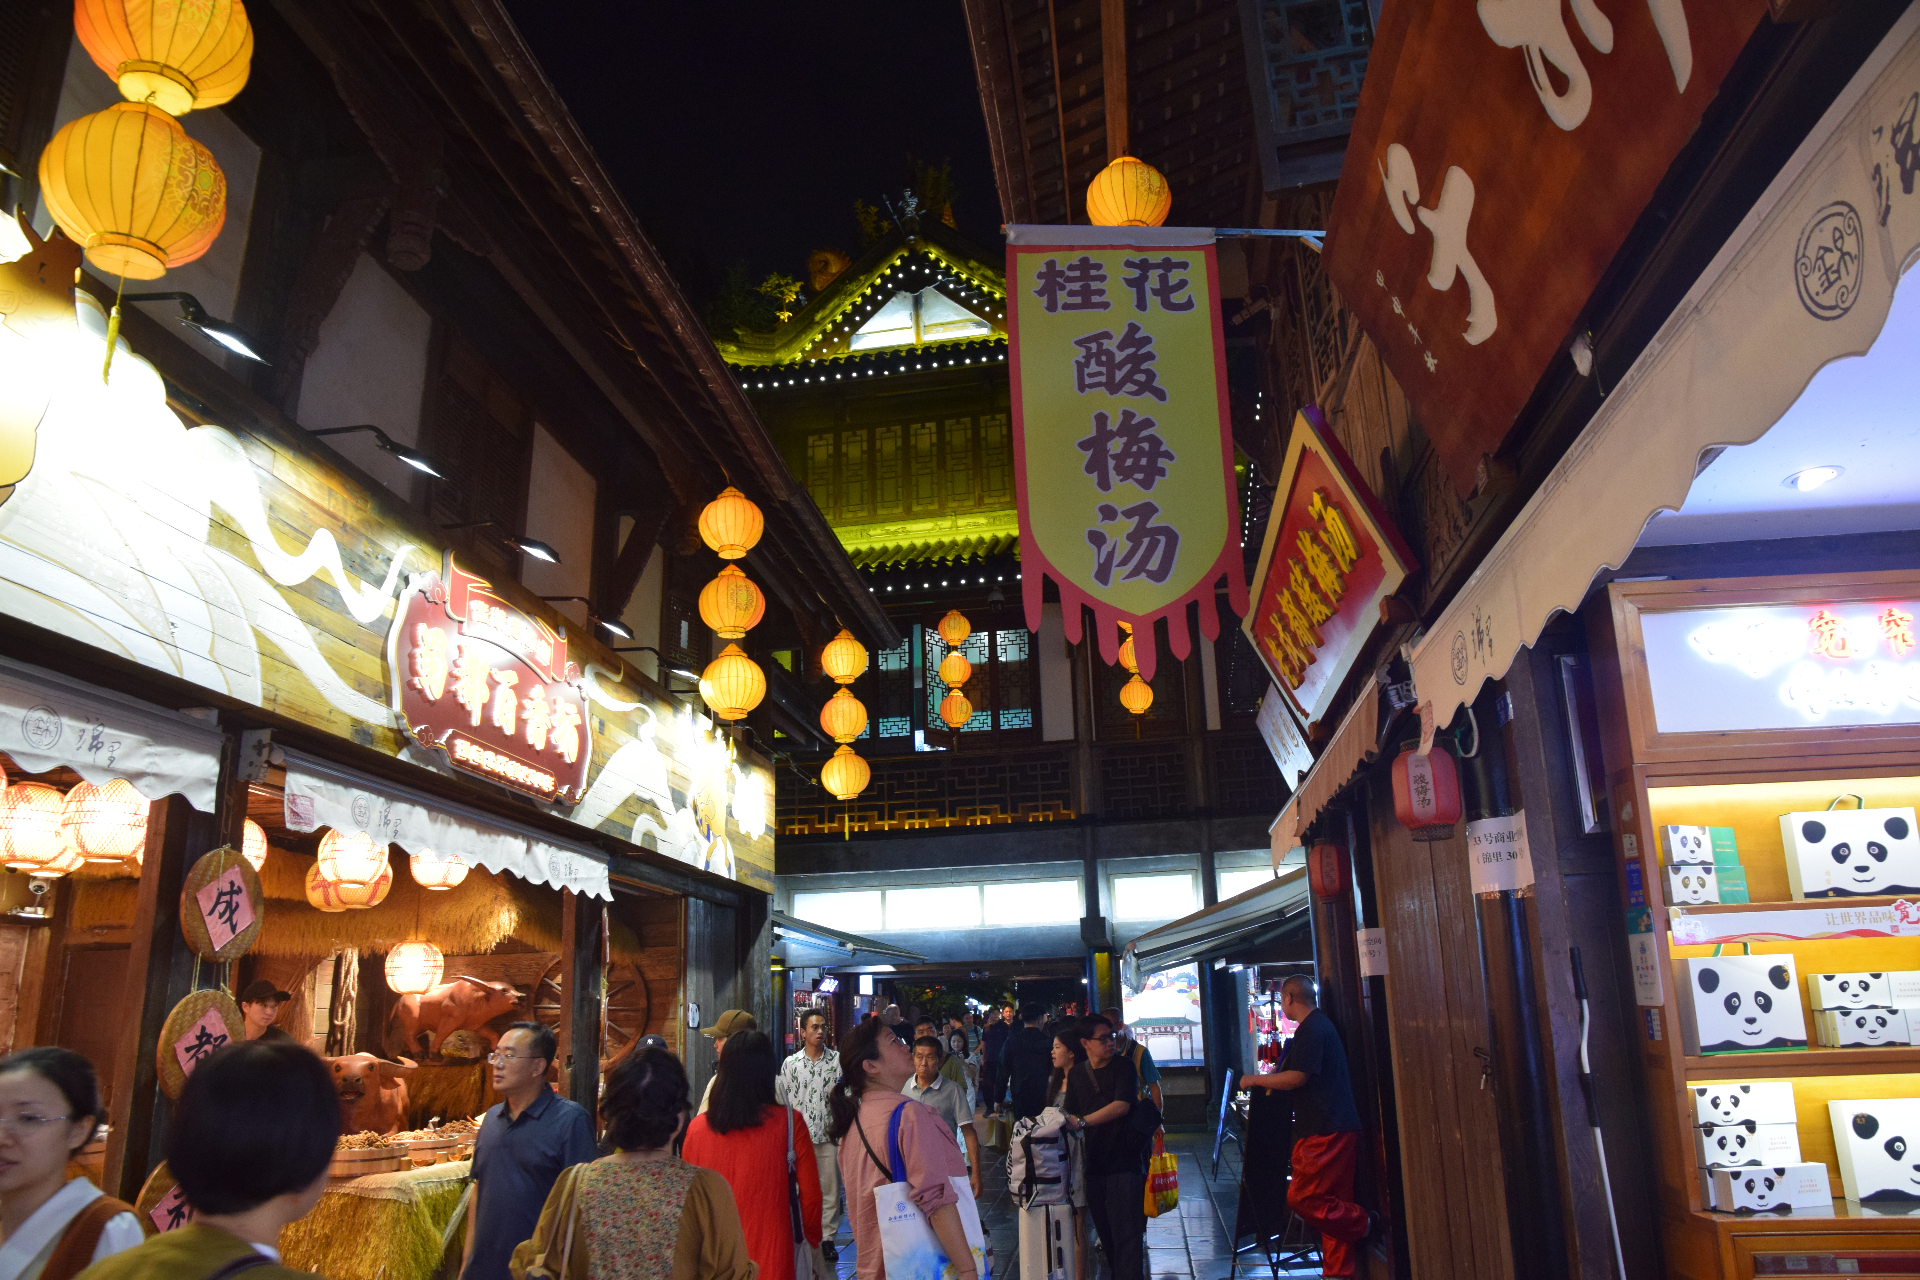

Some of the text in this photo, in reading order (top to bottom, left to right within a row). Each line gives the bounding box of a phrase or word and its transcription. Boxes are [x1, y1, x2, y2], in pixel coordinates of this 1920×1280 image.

[1032, 254, 1196, 315] 桂花
[1073, 320, 1181, 588] 酸梅汤
[1263, 487, 1362, 691] 老成都酸梅汤
[408, 621, 583, 764] 蜀都百香坊
[1412, 771, 1432, 809] 酸梅汤
[206, 879, 243, 935] 成
[1825, 900, 1920, 926] 让世界品味 宽
